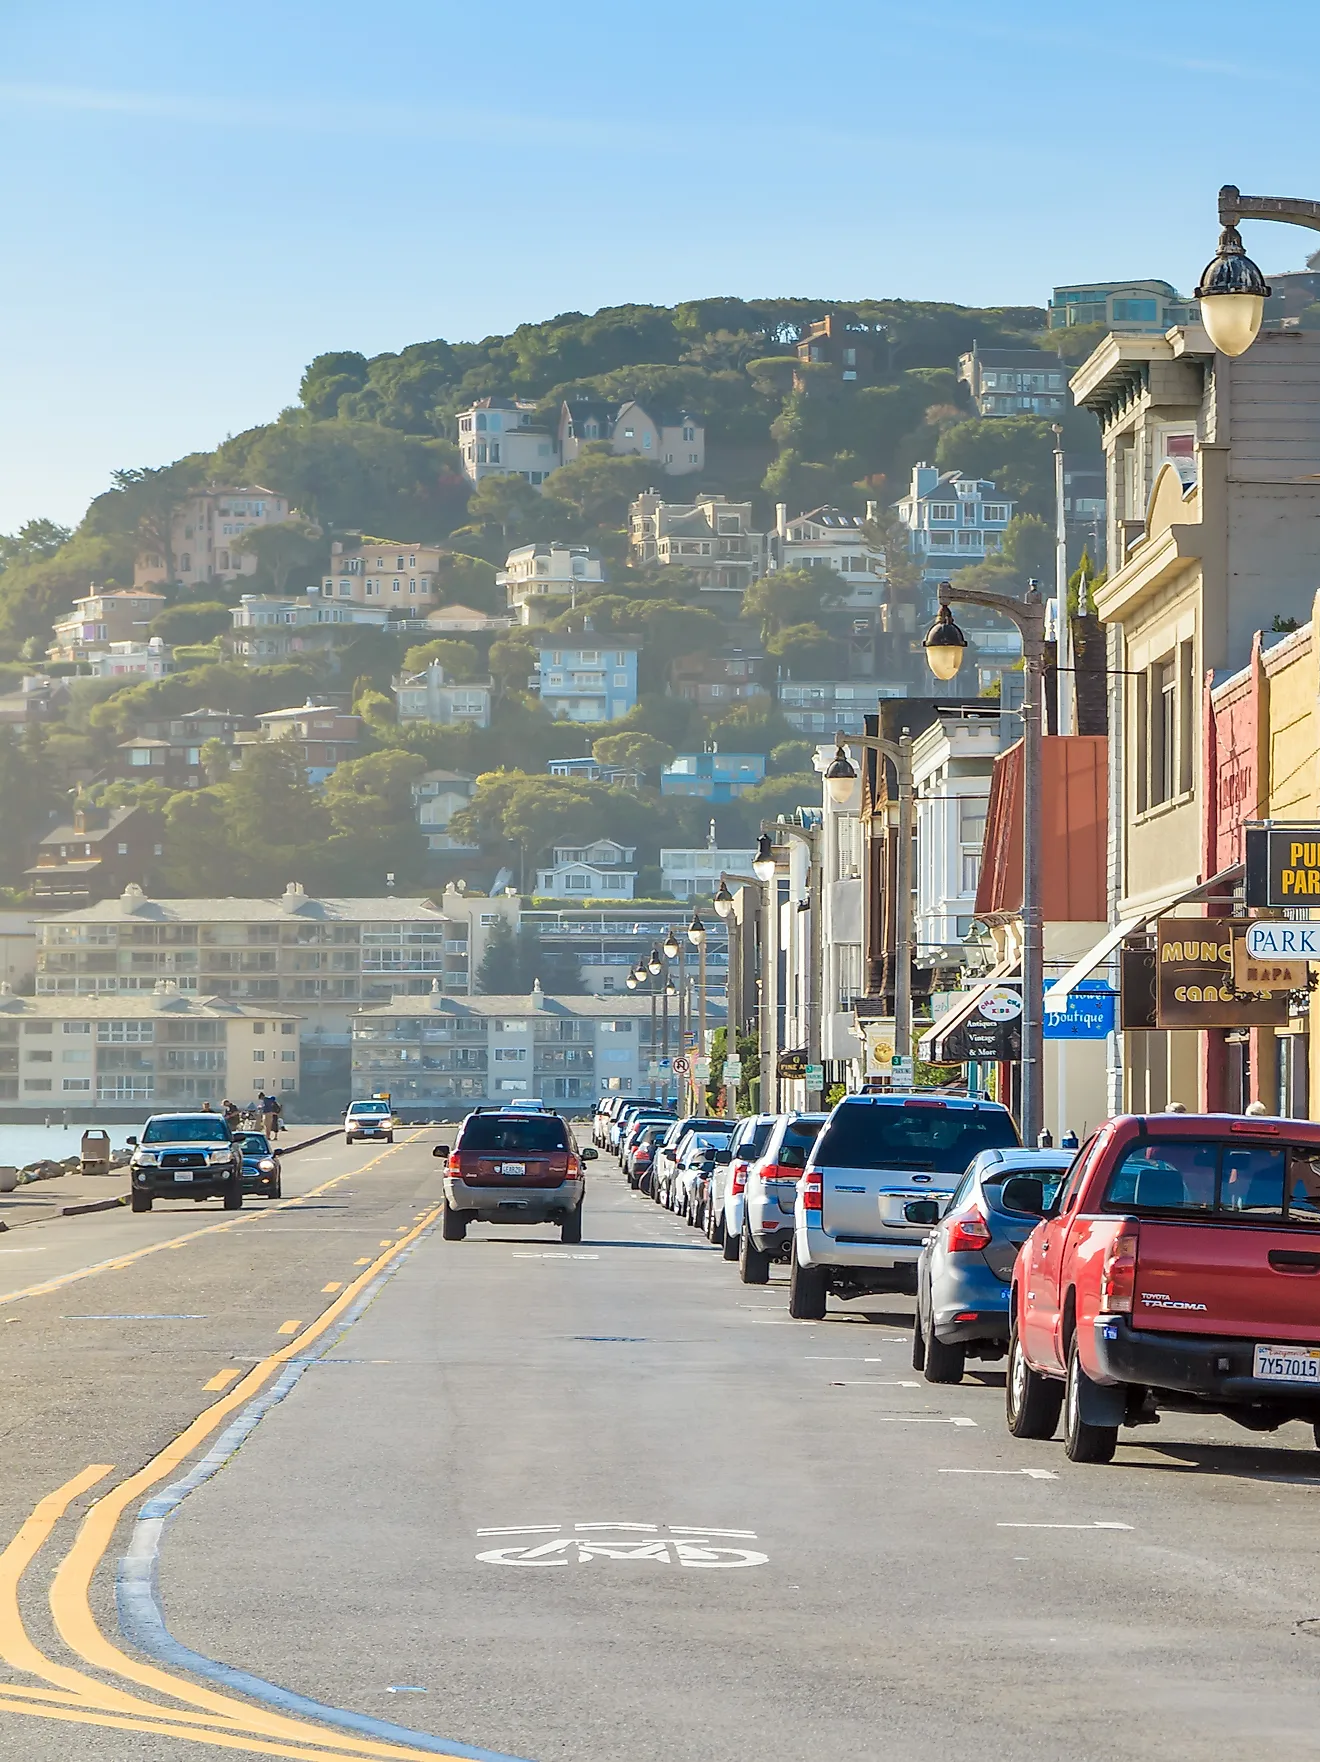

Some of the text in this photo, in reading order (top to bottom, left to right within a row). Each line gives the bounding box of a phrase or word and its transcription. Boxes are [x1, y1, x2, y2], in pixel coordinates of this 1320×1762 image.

[1048, 1010, 1104, 1028] Boutique
[966, 1020, 998, 1029] Antiques
[968, 1034, 996, 1044] Vintage
[1141, 1292, 1171, 1301] TOYOTA
[1141, 1300, 1208, 1311] TACOMA
[1259, 1357, 1317, 1377] 7Y57015
